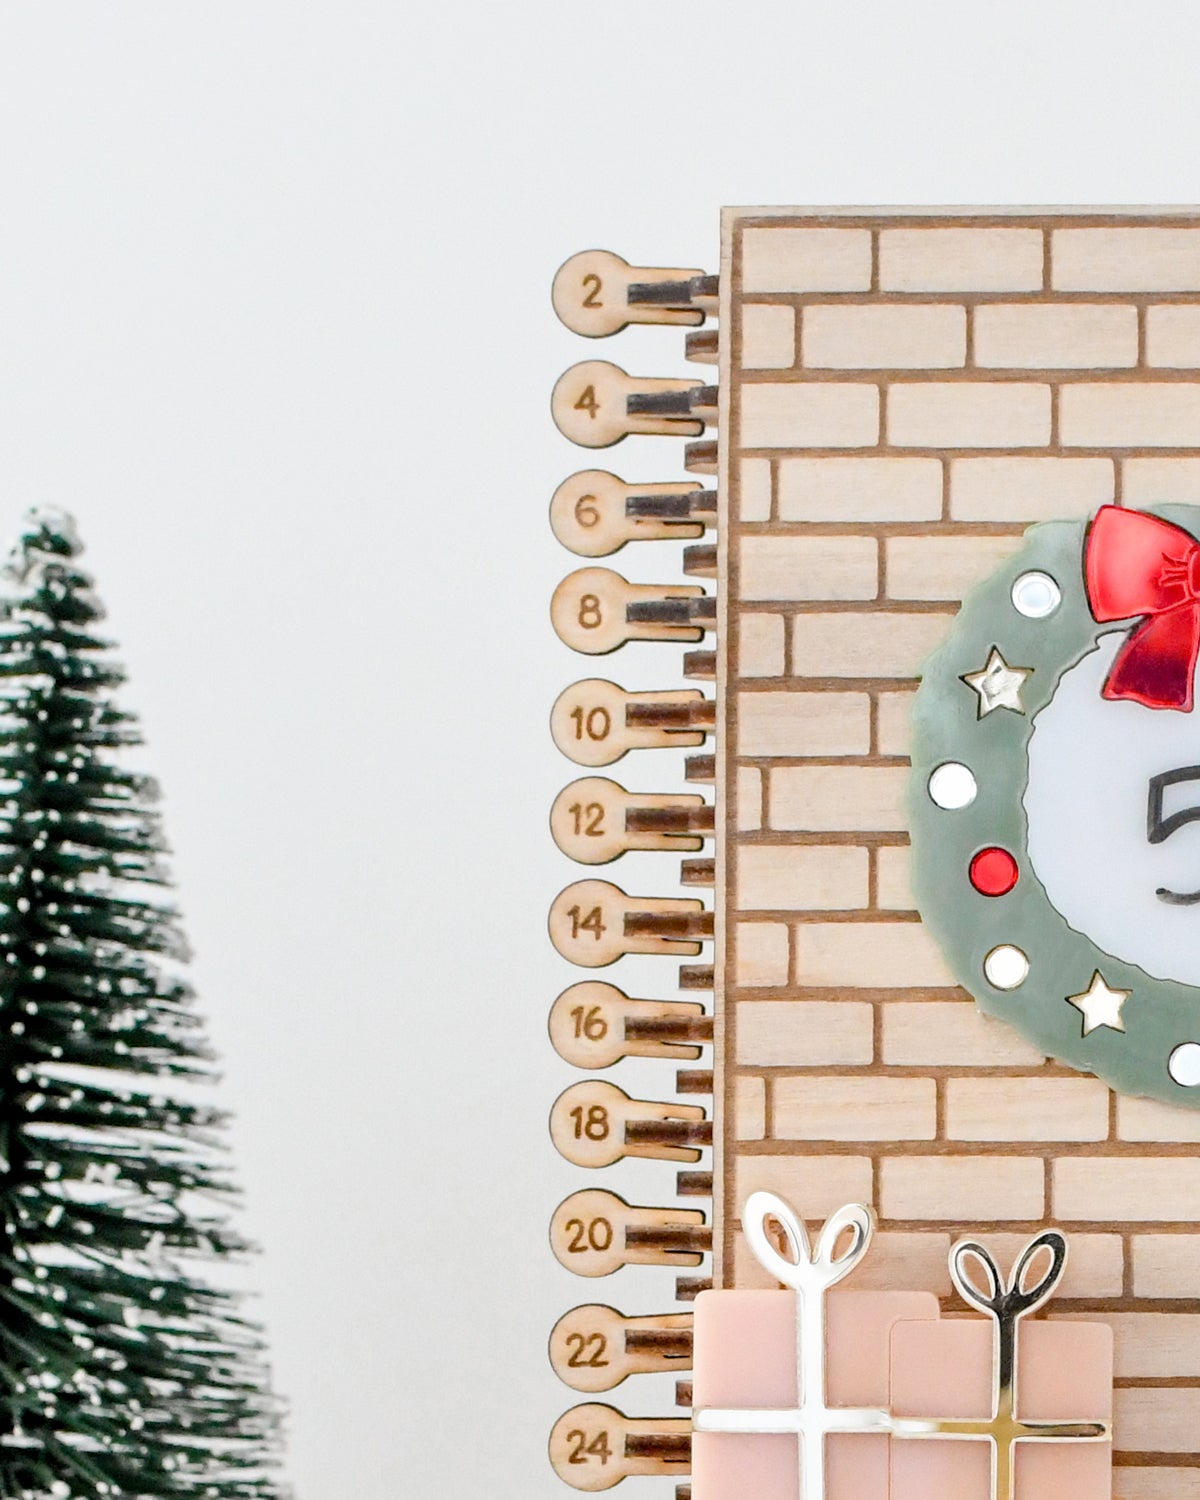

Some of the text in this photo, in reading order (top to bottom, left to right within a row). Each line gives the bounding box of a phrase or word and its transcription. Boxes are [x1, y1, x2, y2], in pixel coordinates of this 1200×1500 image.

[583, 274, 602, 308] 2
[574, 385, 600, 418] 4
[575, 495, 600, 527] 6
[579, 594, 601, 629] 8
[571, 706, 610, 740] 10
[569, 803, 604, 836] 12
[567, 905, 606, 940] 14
[571, 1006, 607, 1040] 16
[570, 1106, 609, 1141] 18
[566, 1218, 612, 1253] 20
[567, 1333, 608, 1367] 22
[567, 1430, 612, 1464] 24
